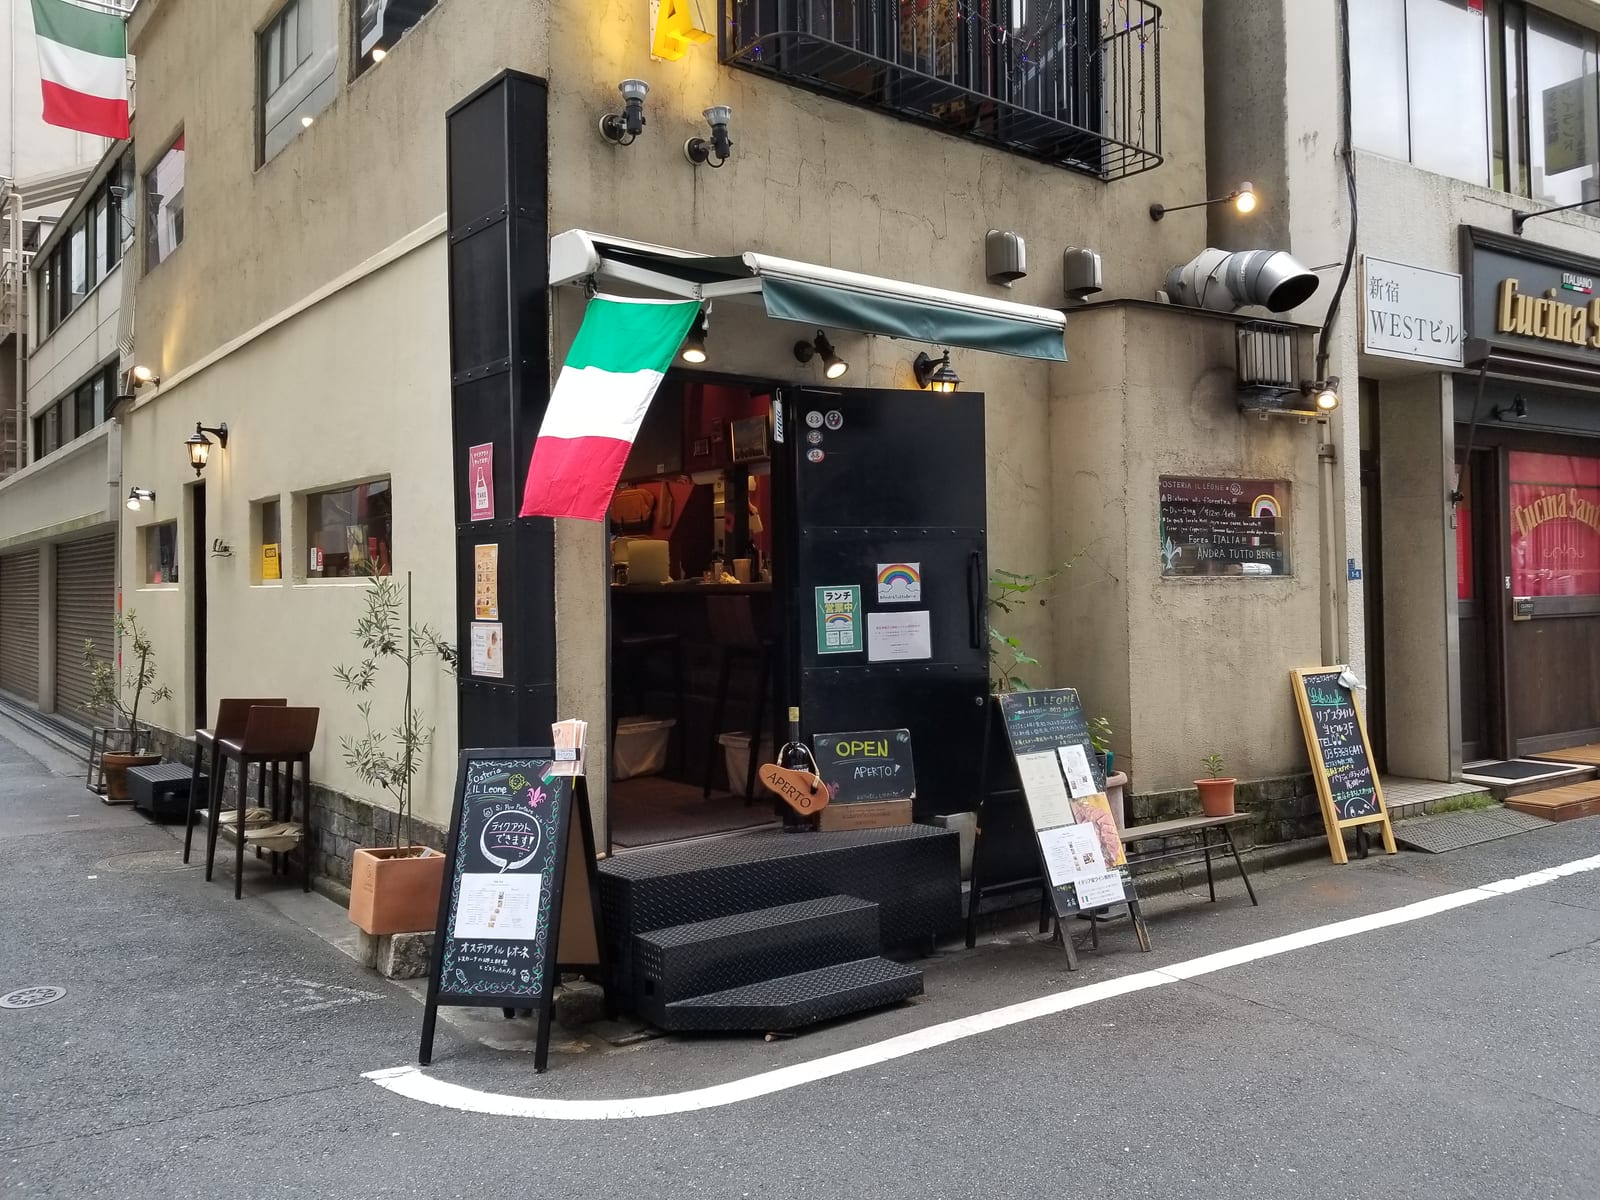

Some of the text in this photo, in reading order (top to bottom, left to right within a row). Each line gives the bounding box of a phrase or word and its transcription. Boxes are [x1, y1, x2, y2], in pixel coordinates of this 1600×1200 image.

[1369, 276, 1399, 303] 新宿
[1562, 272, 1593, 289] ITALIANO
[1499, 277, 1587, 345] Cucina
[1369, 309, 1459, 344] WESTビル
[1515, 489, 1568, 538] Cucina
[1229, 549, 1254, 559] TUTTO
[825, 591, 851, 601] ランチ
[835, 738, 888, 757] OPEN
[766, 772, 812, 808] APERTO
